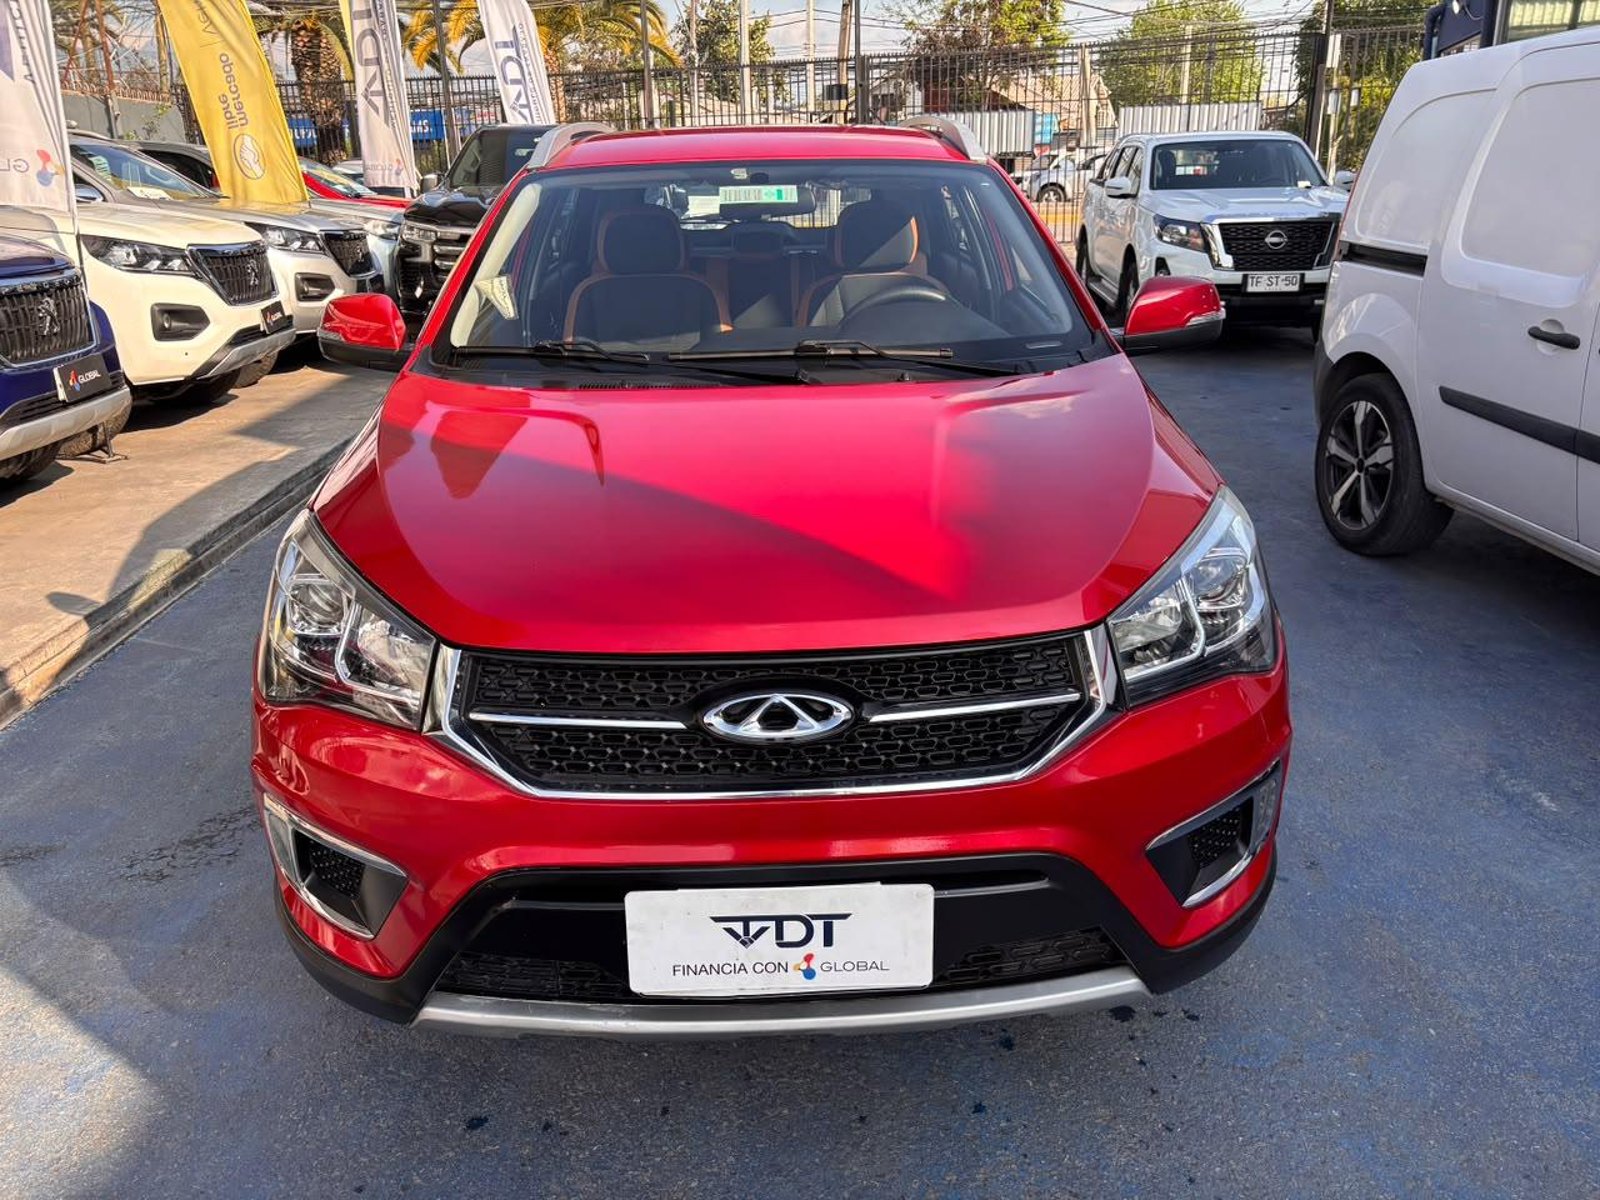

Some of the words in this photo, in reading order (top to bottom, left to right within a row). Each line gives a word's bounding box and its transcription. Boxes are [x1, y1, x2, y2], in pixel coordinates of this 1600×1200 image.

[78, 369, 102, 384] GLOBAL
[672, 962, 748, 977] FINANCIA
[752, 961, 789, 974] CON
[820, 960, 890, 973] GLOBAL
